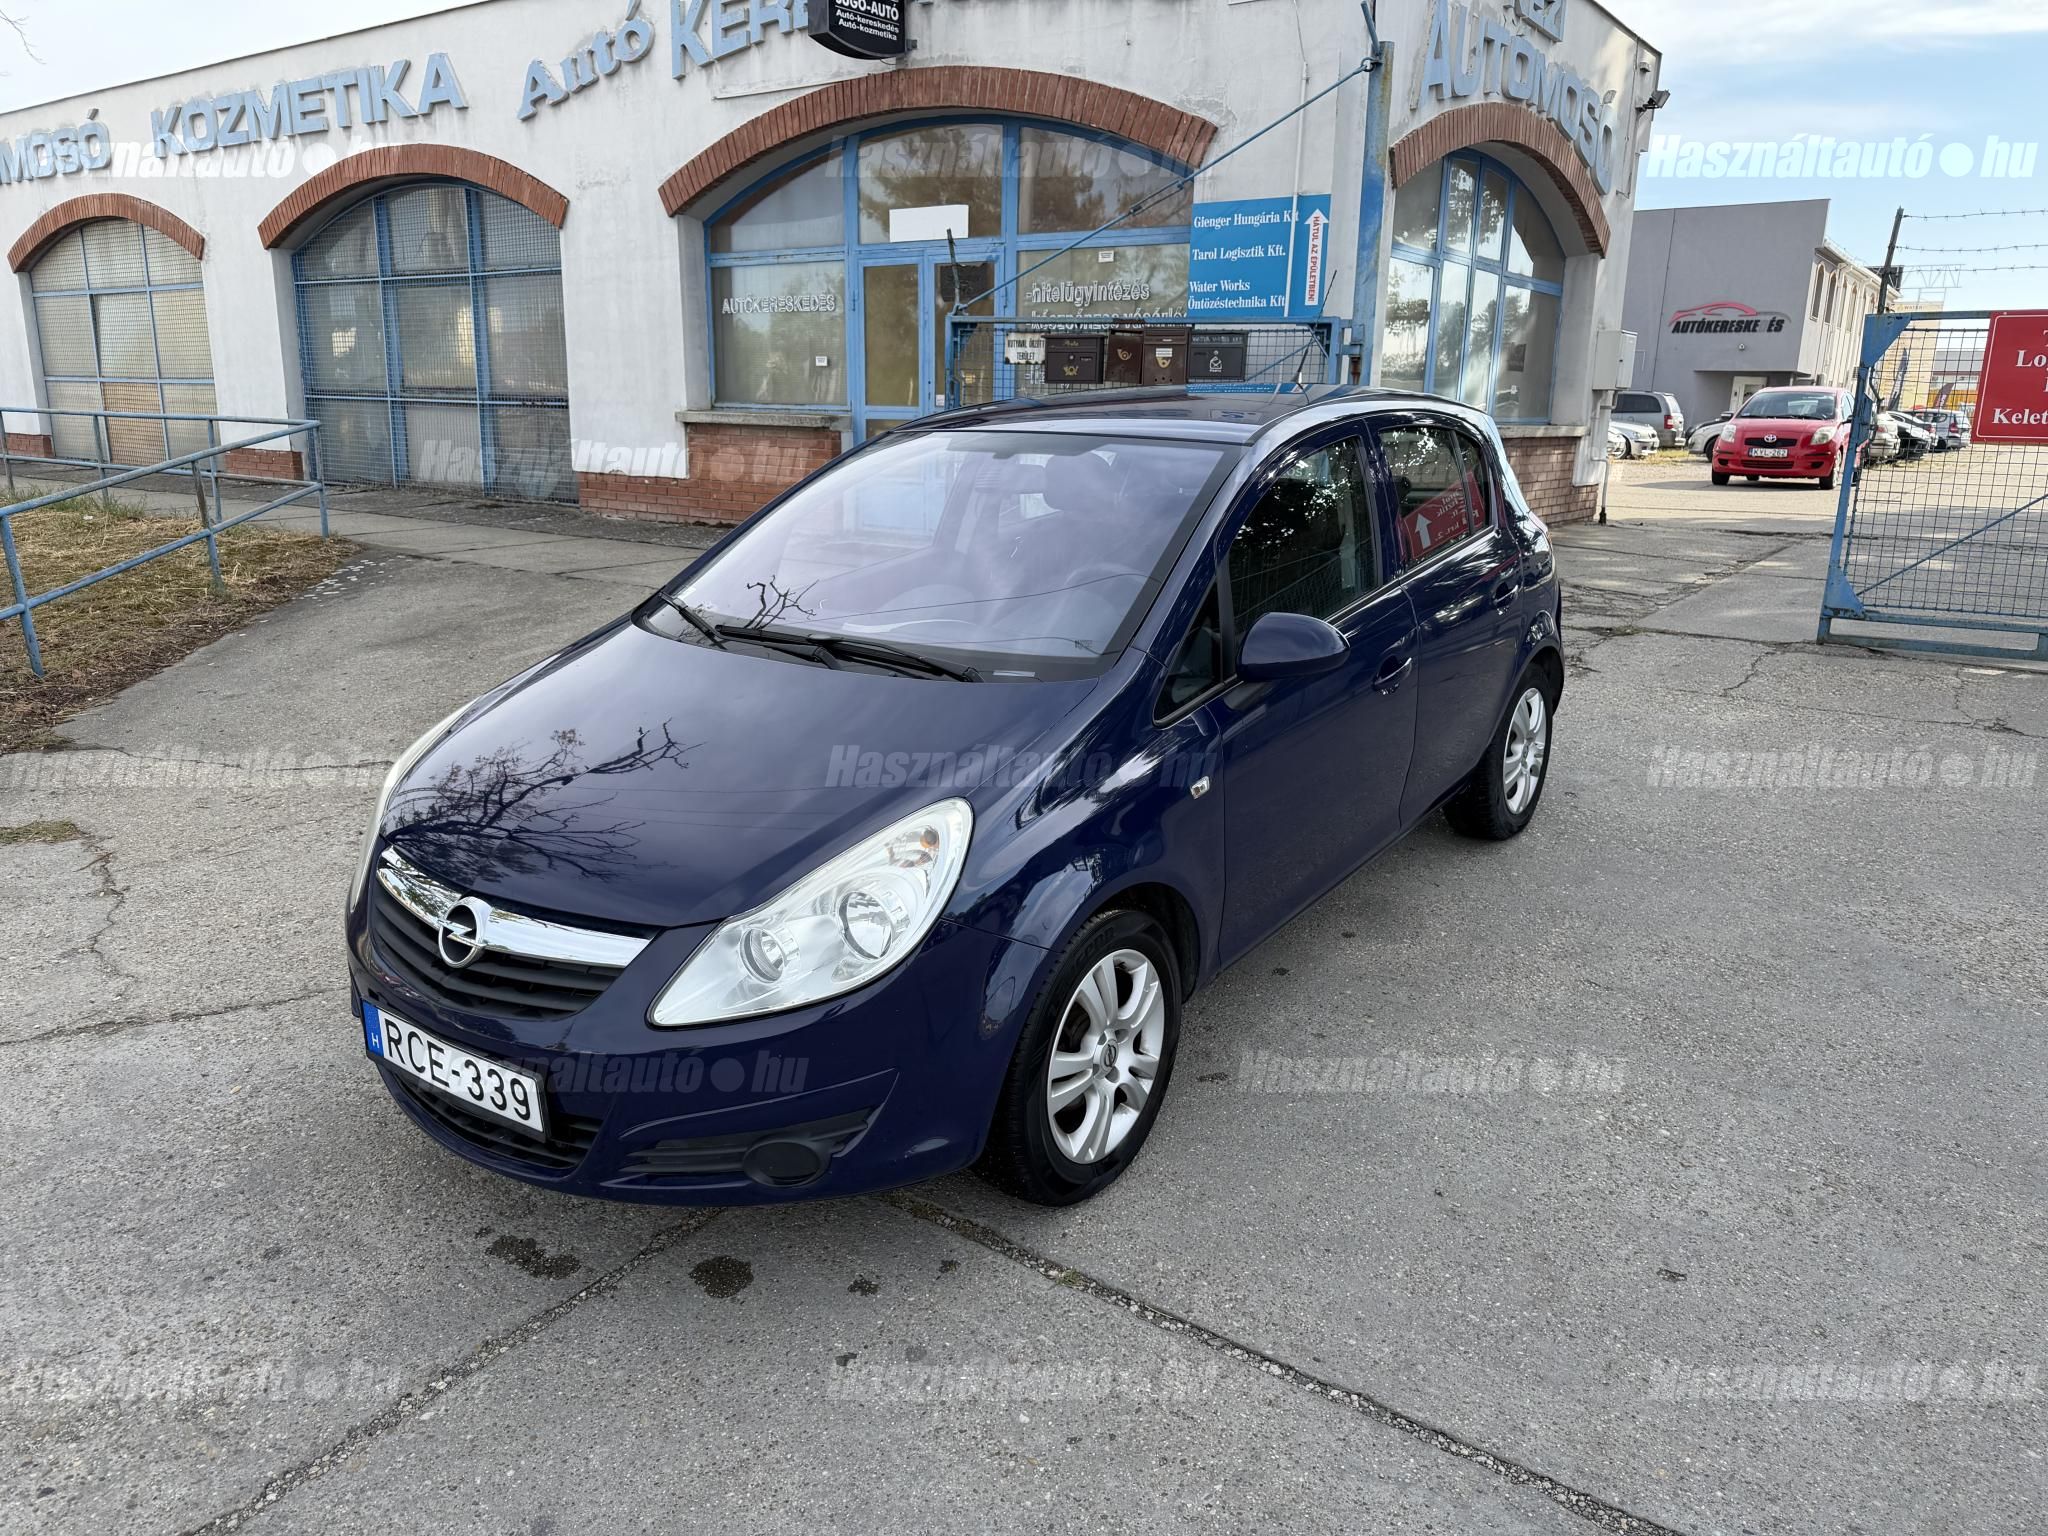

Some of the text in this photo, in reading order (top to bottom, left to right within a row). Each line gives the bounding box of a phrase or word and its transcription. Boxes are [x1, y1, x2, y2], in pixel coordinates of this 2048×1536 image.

[836, 9, 900, 33] Autó-kereskedés
[839, 18, 897, 41] Autó-kozmetika
[516, 0, 656, 121] Autó
[150, 52, 469, 158] KOZMETIKA
[1193, 216, 1232, 230] Gienger
[1233, 212, 1280, 228] Hungária
[1192, 244, 1286, 262] Tarol Logisztik Kft.
[1189, 280, 1251, 292] Water Works
[1187, 296, 1267, 310] Öntözéstechnika
[371, 1032, 381, 1049] H
[384, 1017, 531, 1121] RCE-339
